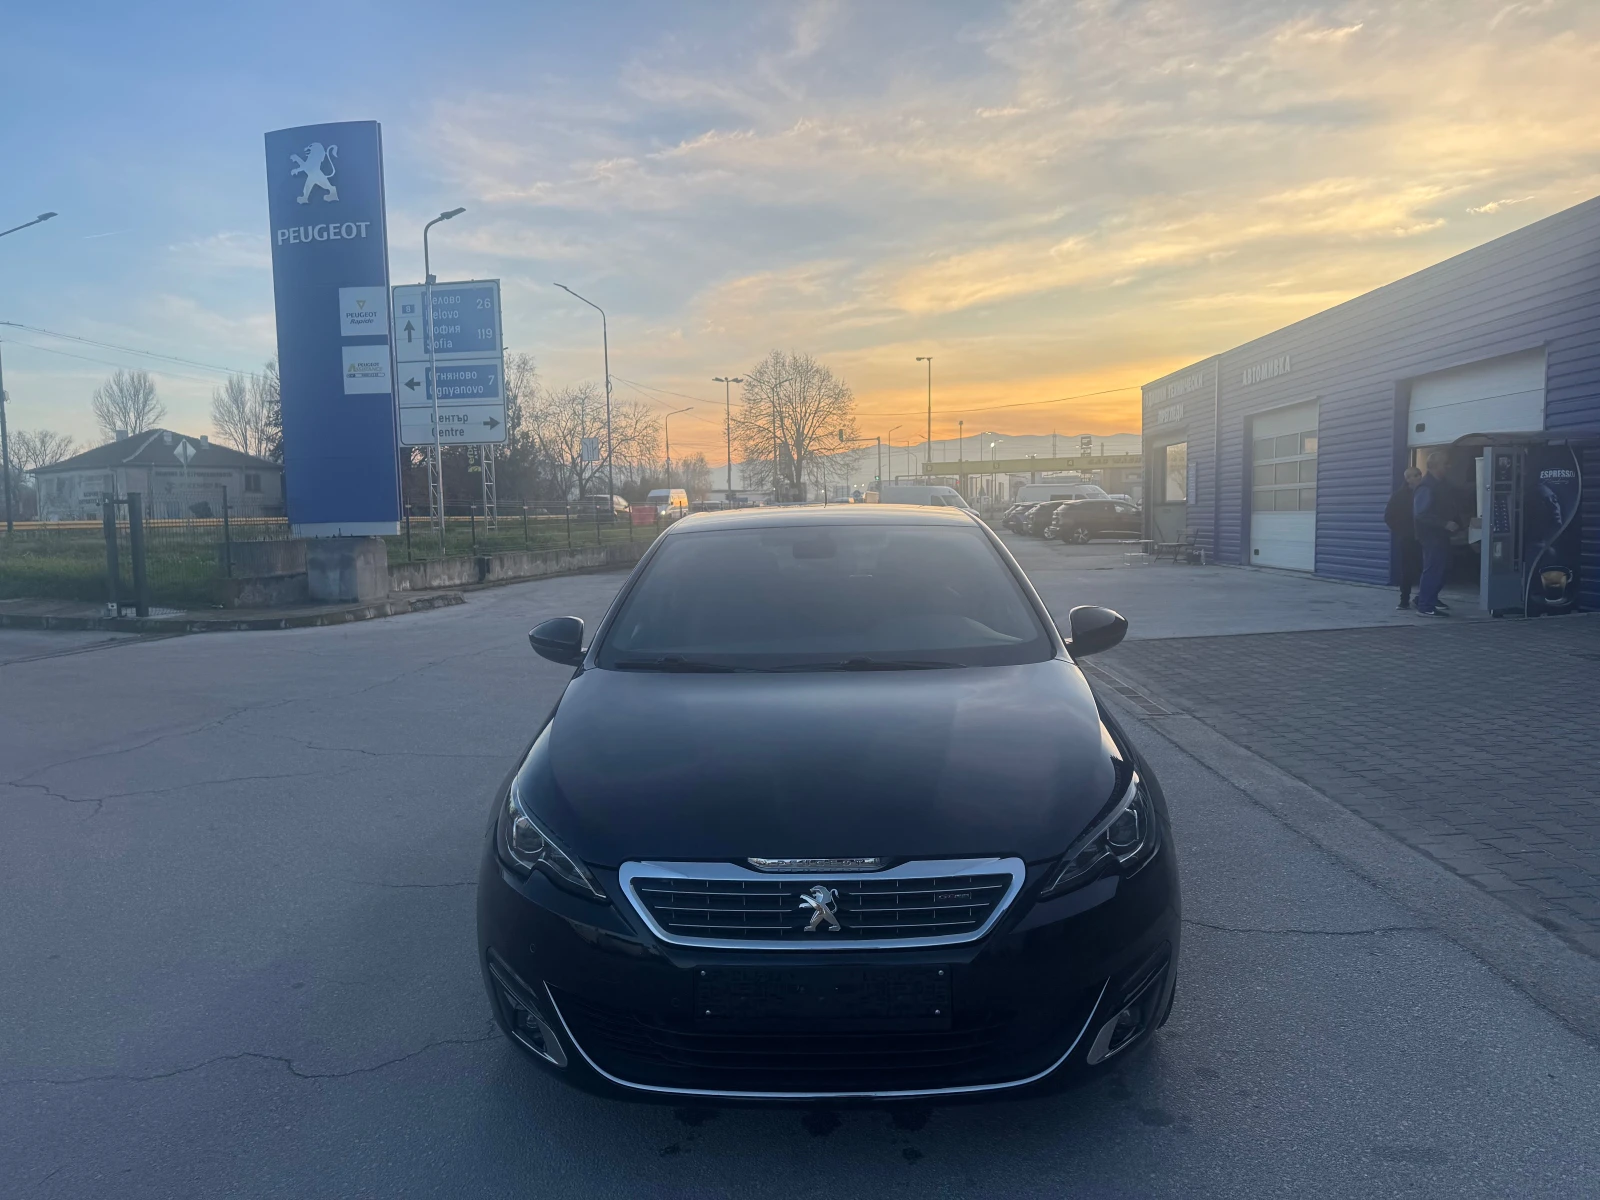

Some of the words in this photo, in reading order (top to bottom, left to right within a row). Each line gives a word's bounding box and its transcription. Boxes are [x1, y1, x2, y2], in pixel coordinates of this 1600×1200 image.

[277, 222, 370, 245] PEUGEOT
[476, 298, 491, 309] 26
[477, 328, 493, 339] 119
[1242, 355, 1290, 386] АВТОМИВКА
[488, 375, 495, 385] 7
